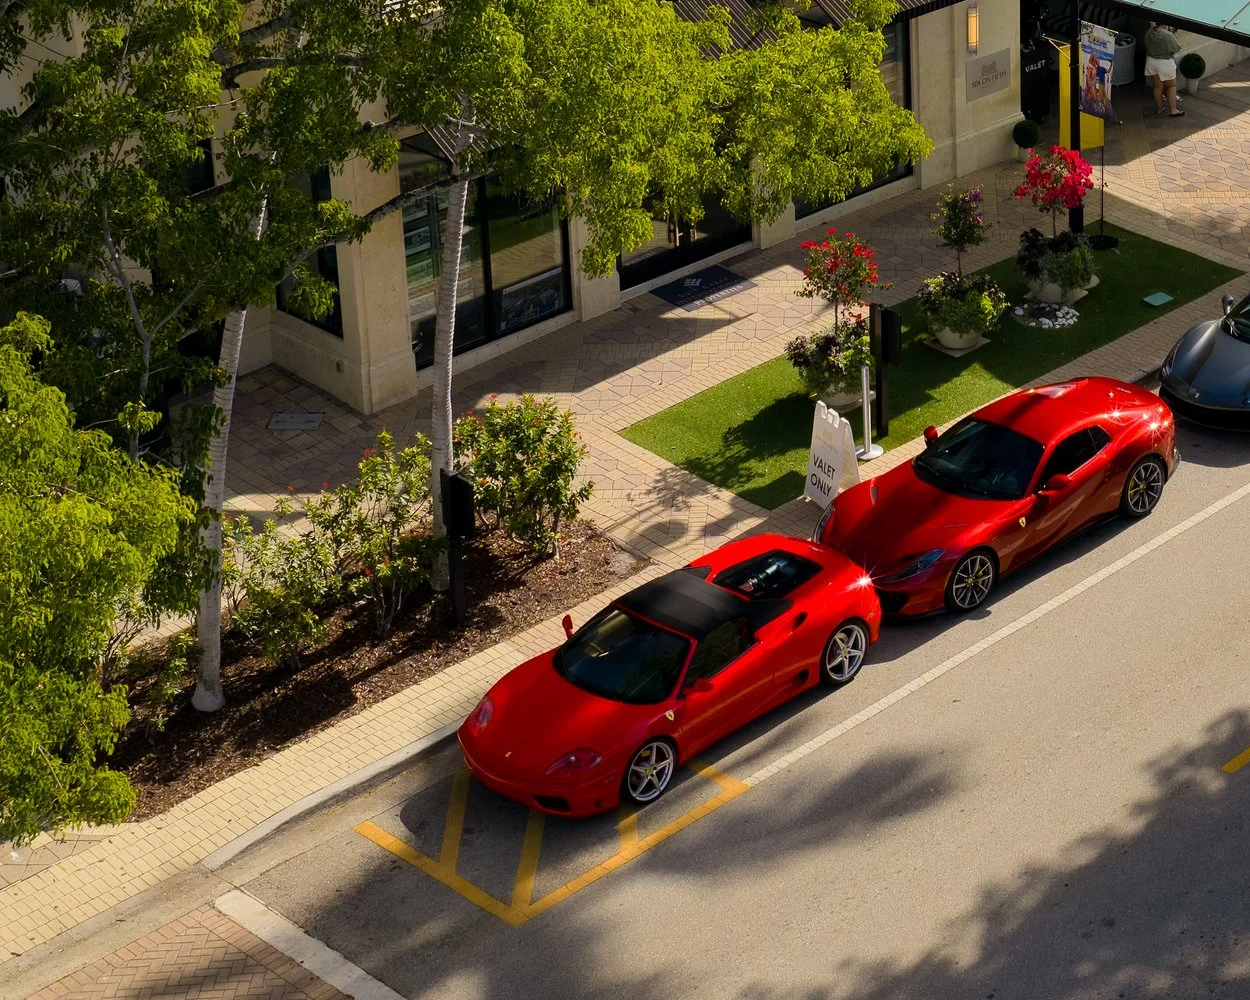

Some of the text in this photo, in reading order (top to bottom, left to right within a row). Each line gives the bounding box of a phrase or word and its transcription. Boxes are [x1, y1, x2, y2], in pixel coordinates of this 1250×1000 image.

[1025, 60, 1046, 73] VALET
[813, 453, 836, 480] VALET
[810, 473, 832, 497] ONLY
